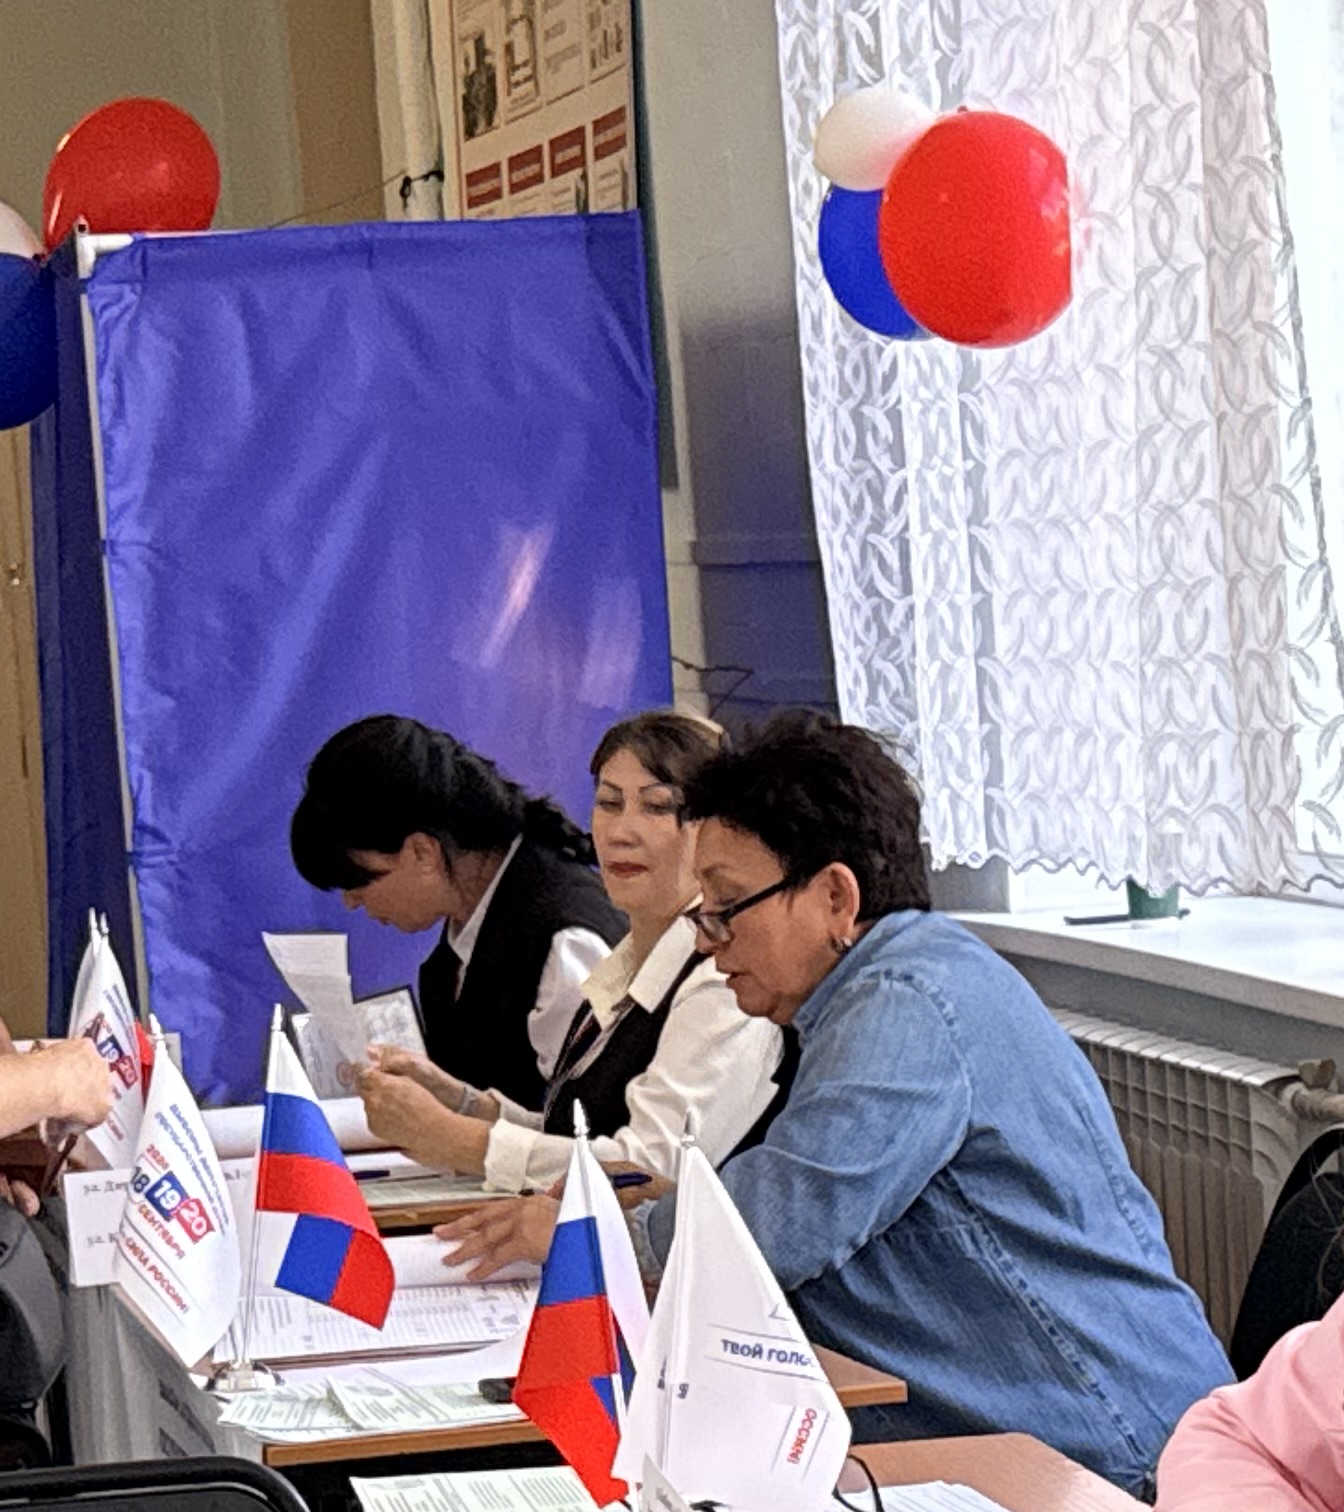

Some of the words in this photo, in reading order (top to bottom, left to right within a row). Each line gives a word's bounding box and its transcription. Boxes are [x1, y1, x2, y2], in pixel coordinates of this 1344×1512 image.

[130, 1166, 151, 1193] 18
[154, 1179, 181, 1210] 19
[137, 1204, 187, 1260] СЕНТЯБРЯ
[179, 1201, 208, 1237] 20
[124, 1236, 150, 1267] СИЛА
[721, 1338, 764, 1361] ТВОЙ
[786, 1408, 819, 1466] ОССИИ!
